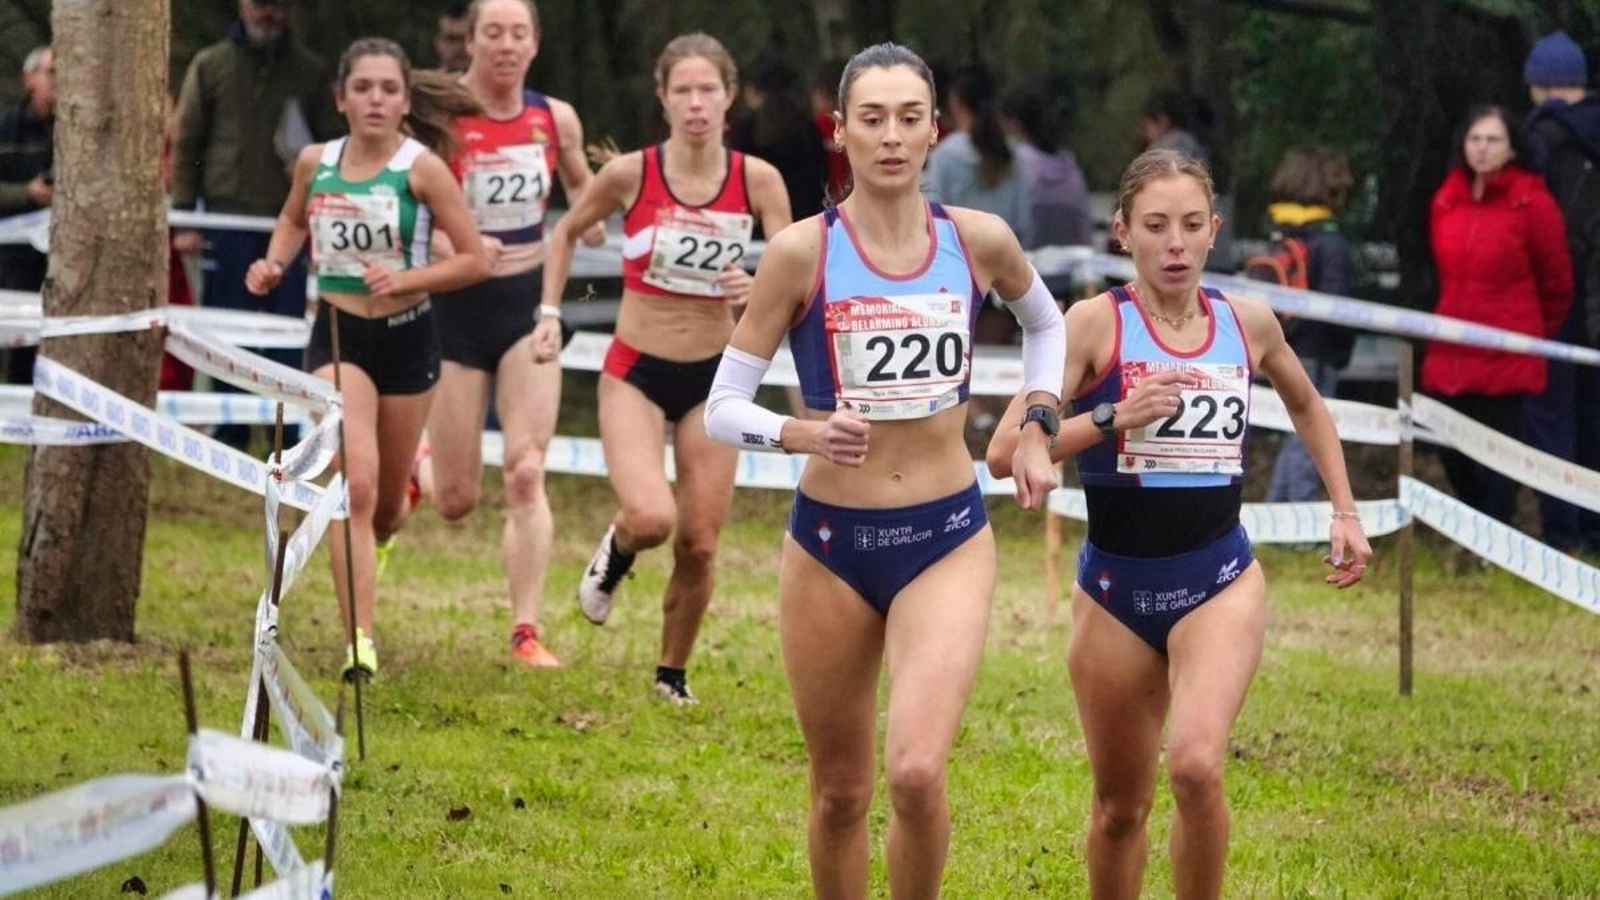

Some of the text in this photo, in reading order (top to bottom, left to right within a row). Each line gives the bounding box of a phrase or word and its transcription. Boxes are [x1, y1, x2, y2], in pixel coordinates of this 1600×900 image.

[486, 170, 543, 205] 221
[331, 221, 393, 251] 301
[674, 236, 744, 271] 222
[850, 303, 901, 316] MEMORIAL
[851, 317, 908, 331] BELARMINO
[866, 332, 963, 382] 220
[1156, 395, 1245, 440] 223
[878, 526, 913, 538] XUNTA
[944, 518, 971, 533] ZICO
[878, 529, 933, 547] DE GALICIA
[1155, 588, 1189, 601] XUNTA
[1155, 591, 1207, 612] DE GALICIA
